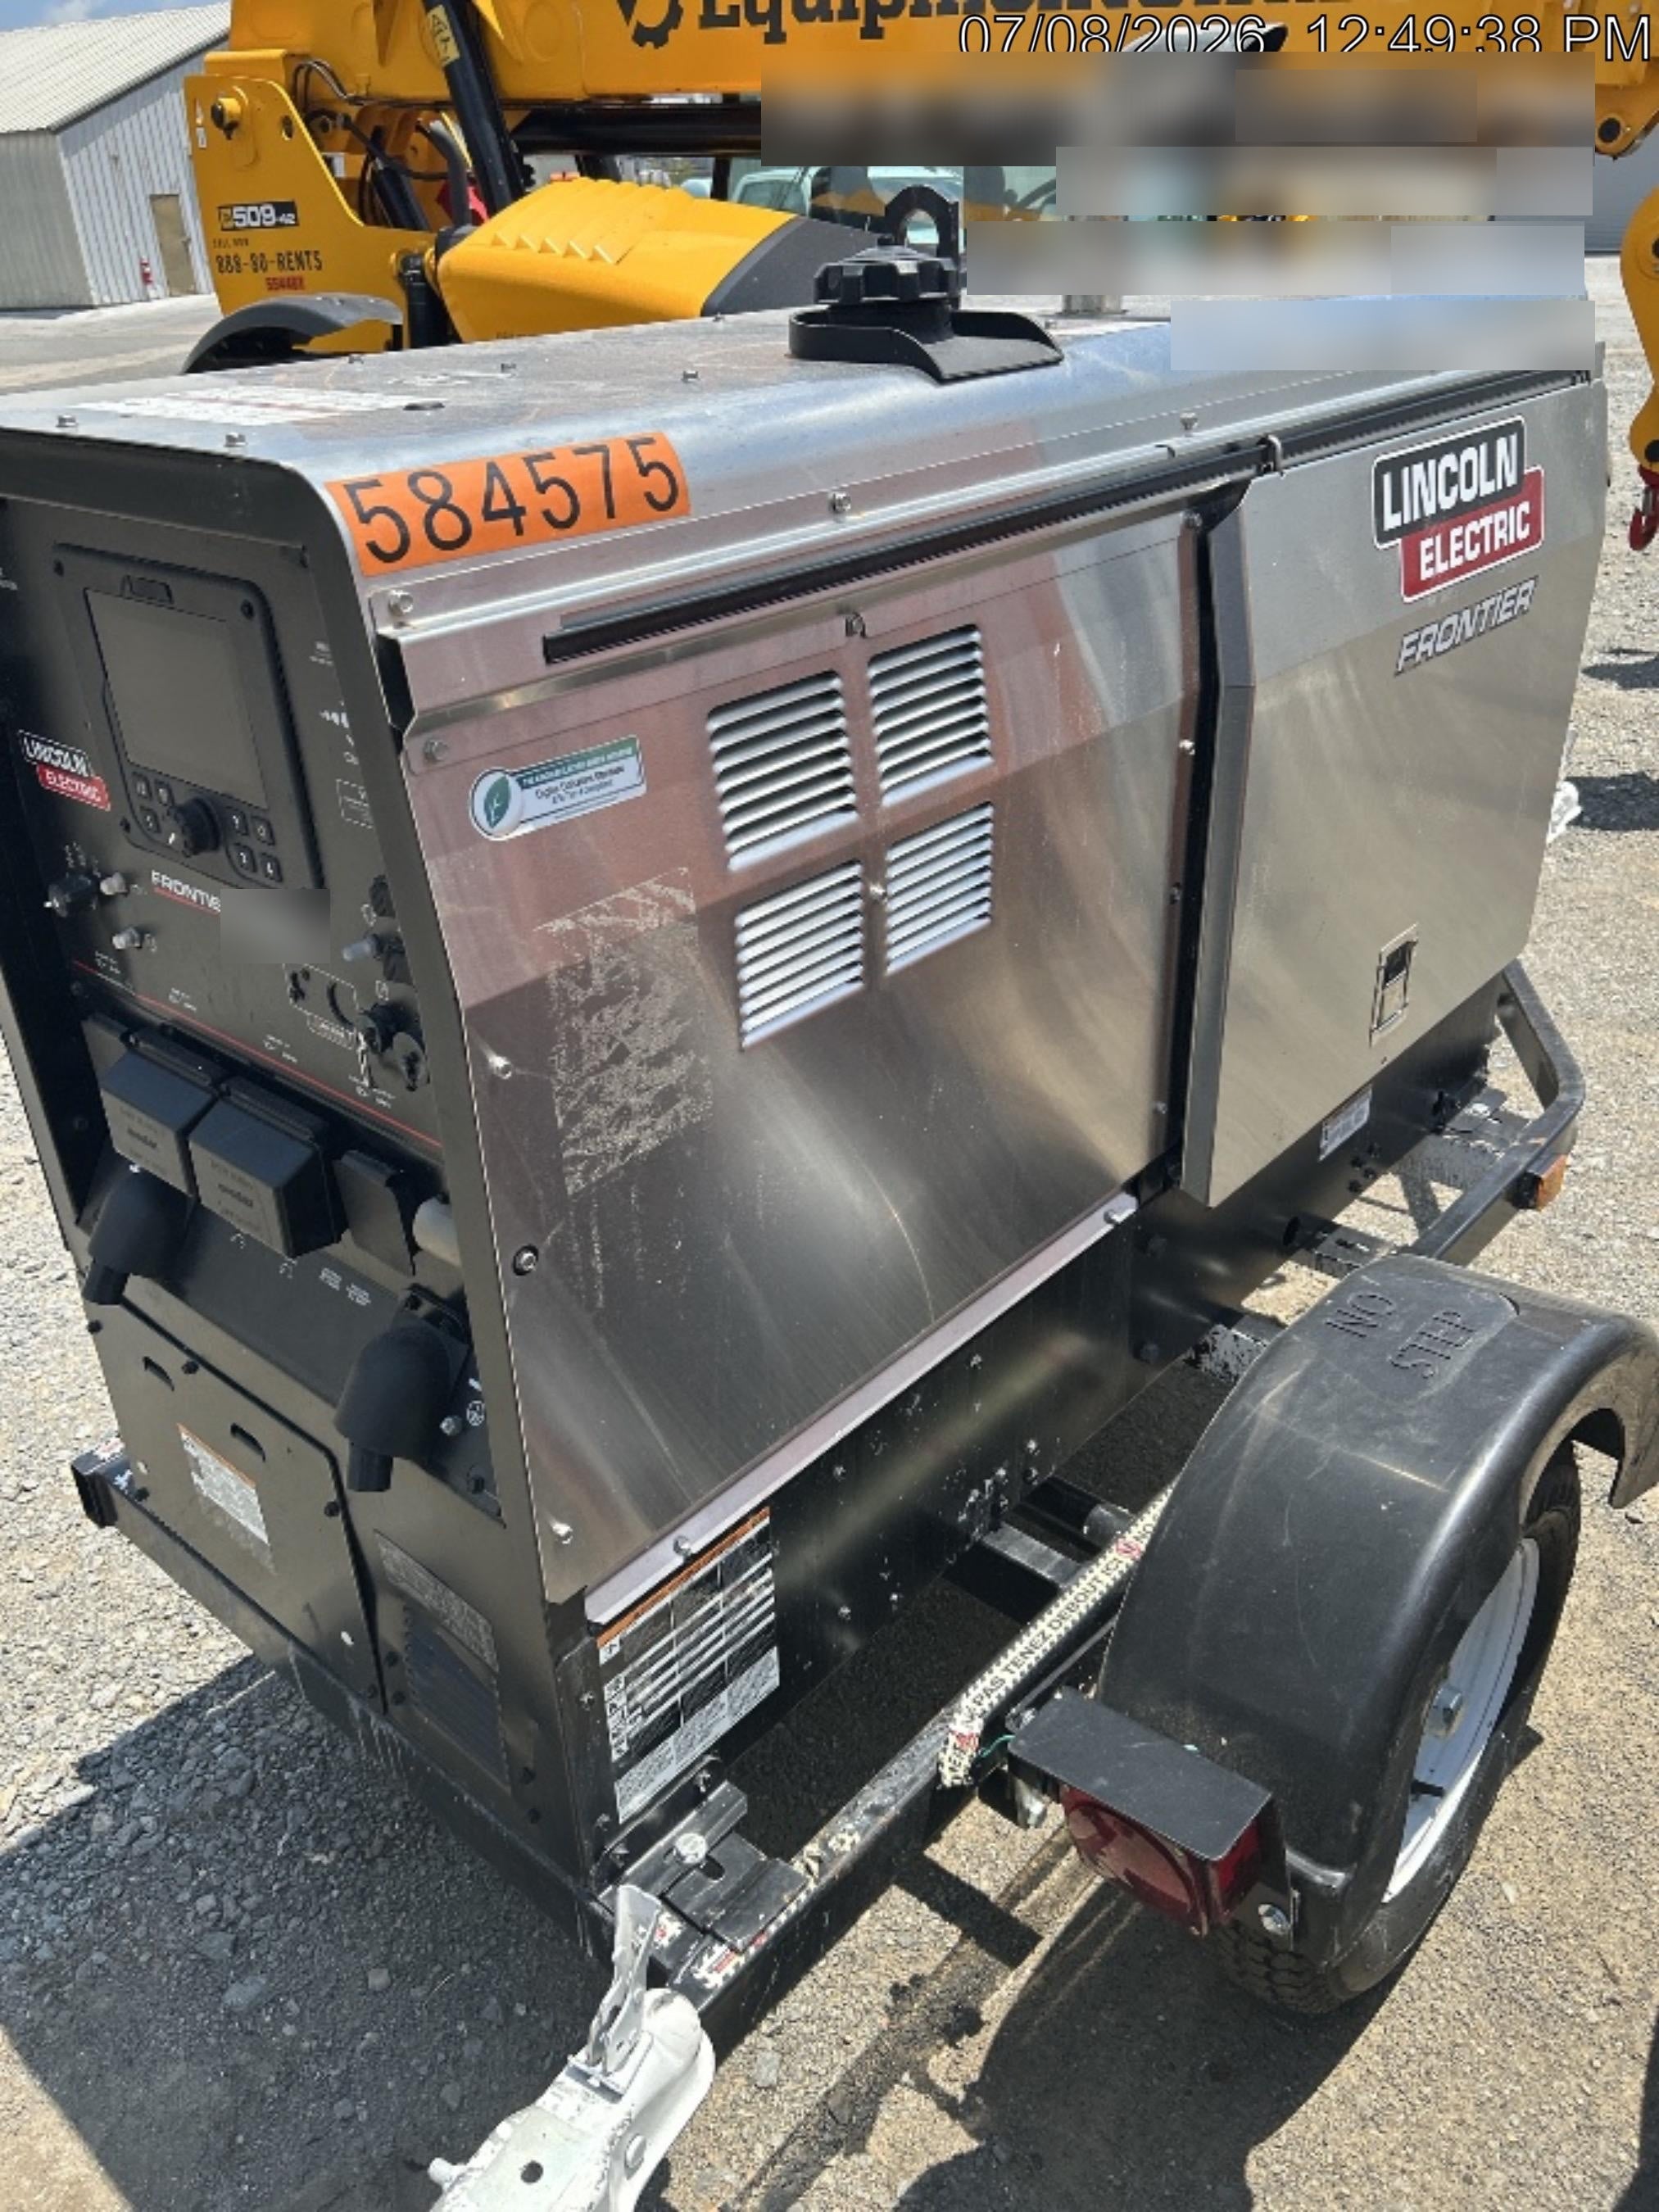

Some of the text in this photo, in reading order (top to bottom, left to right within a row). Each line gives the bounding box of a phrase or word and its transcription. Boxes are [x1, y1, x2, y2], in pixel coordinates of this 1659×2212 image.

[342, 436, 679, 564] 584575
[1383, 432, 1517, 532] LINCOLN
[1419, 500, 1530, 581] ELECTRIC
[1394, 575, 1539, 677] FRONTIER
[1324, 1291, 1396, 1339] NO
[1388, 1311, 1478, 1380] STEP
